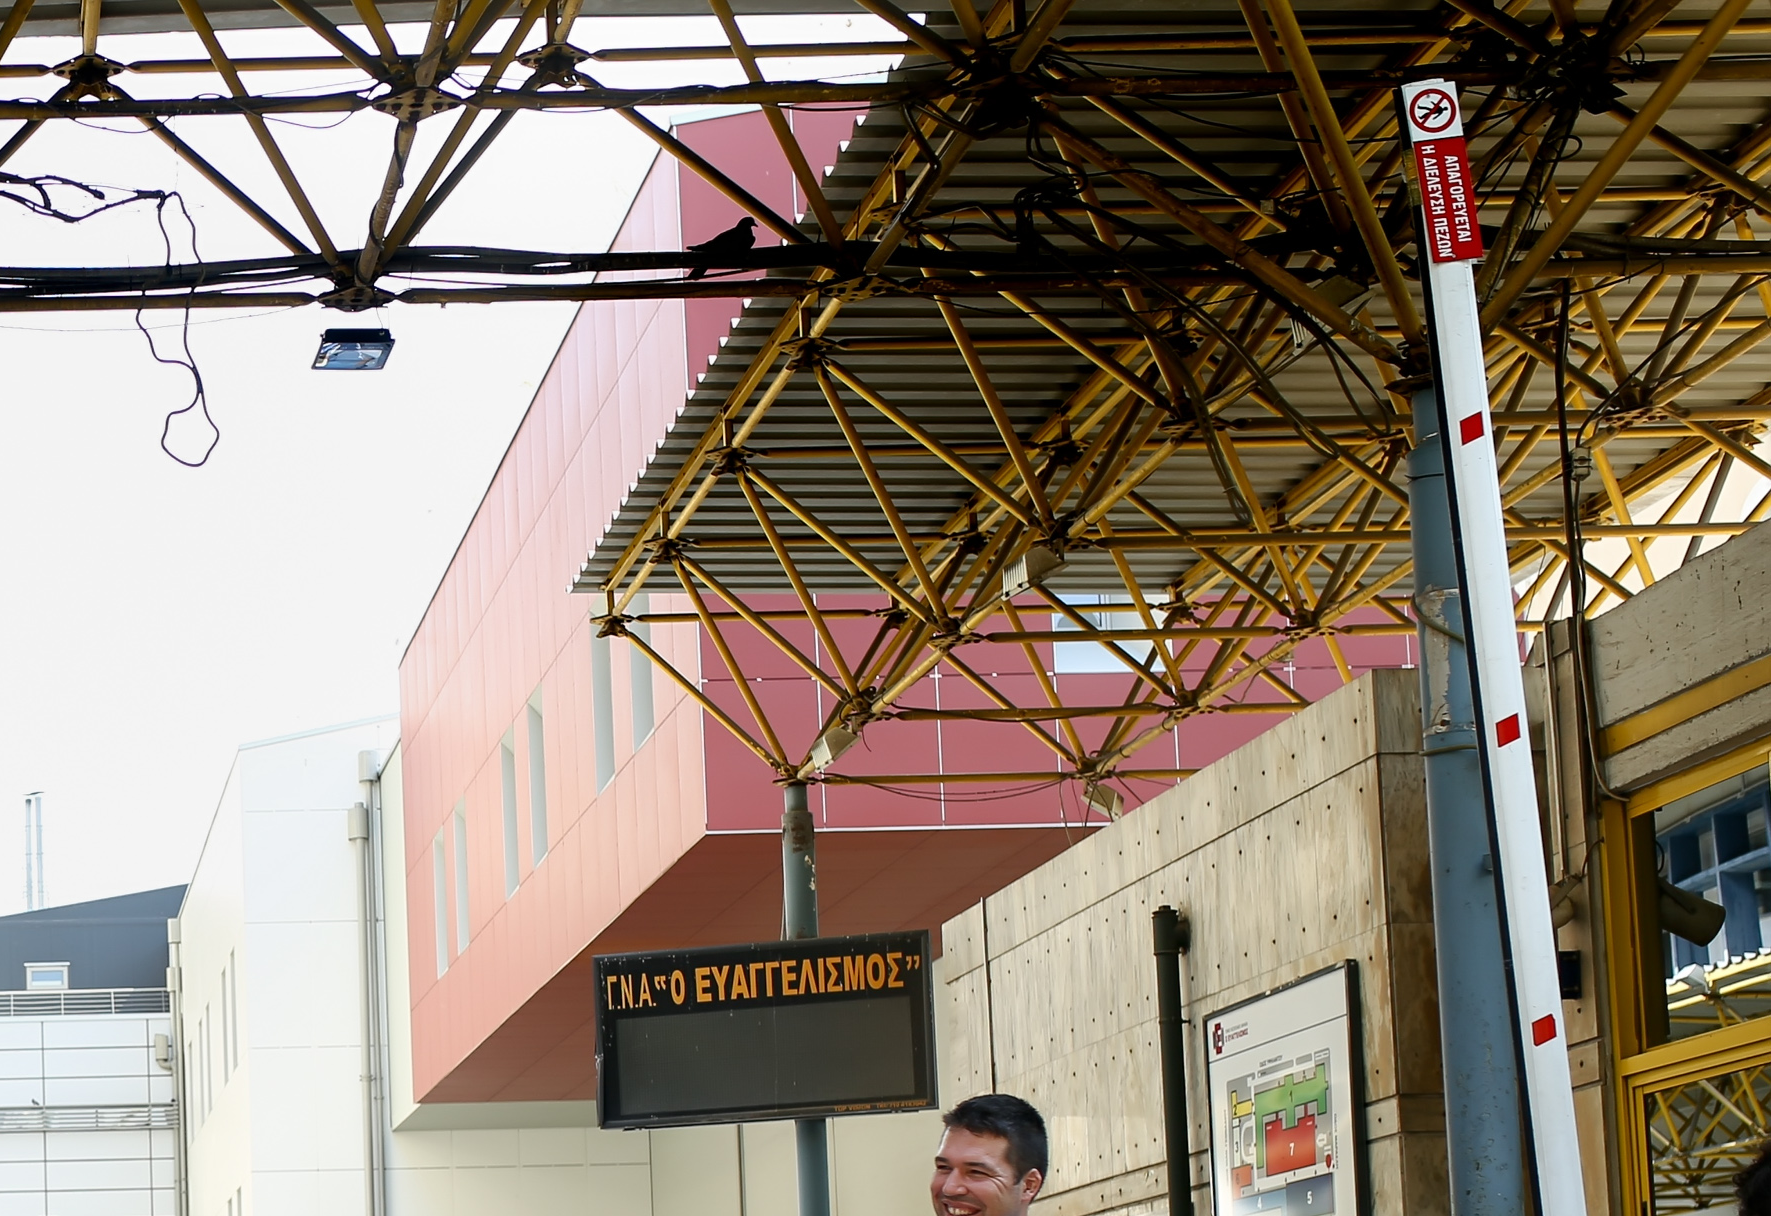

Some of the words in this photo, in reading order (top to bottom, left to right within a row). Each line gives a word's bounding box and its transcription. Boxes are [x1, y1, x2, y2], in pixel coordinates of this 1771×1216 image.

[1421, 145, 1435, 154] Η
[1423, 158, 1446, 215] ΔΙΕΛΕΥΣΗ
[1444, 155, 1472, 242] ΑΠΑΓΟΡΕΥΕΤΑΙ
[1434, 217, 1453, 257] ΠΕΖΩΝ
